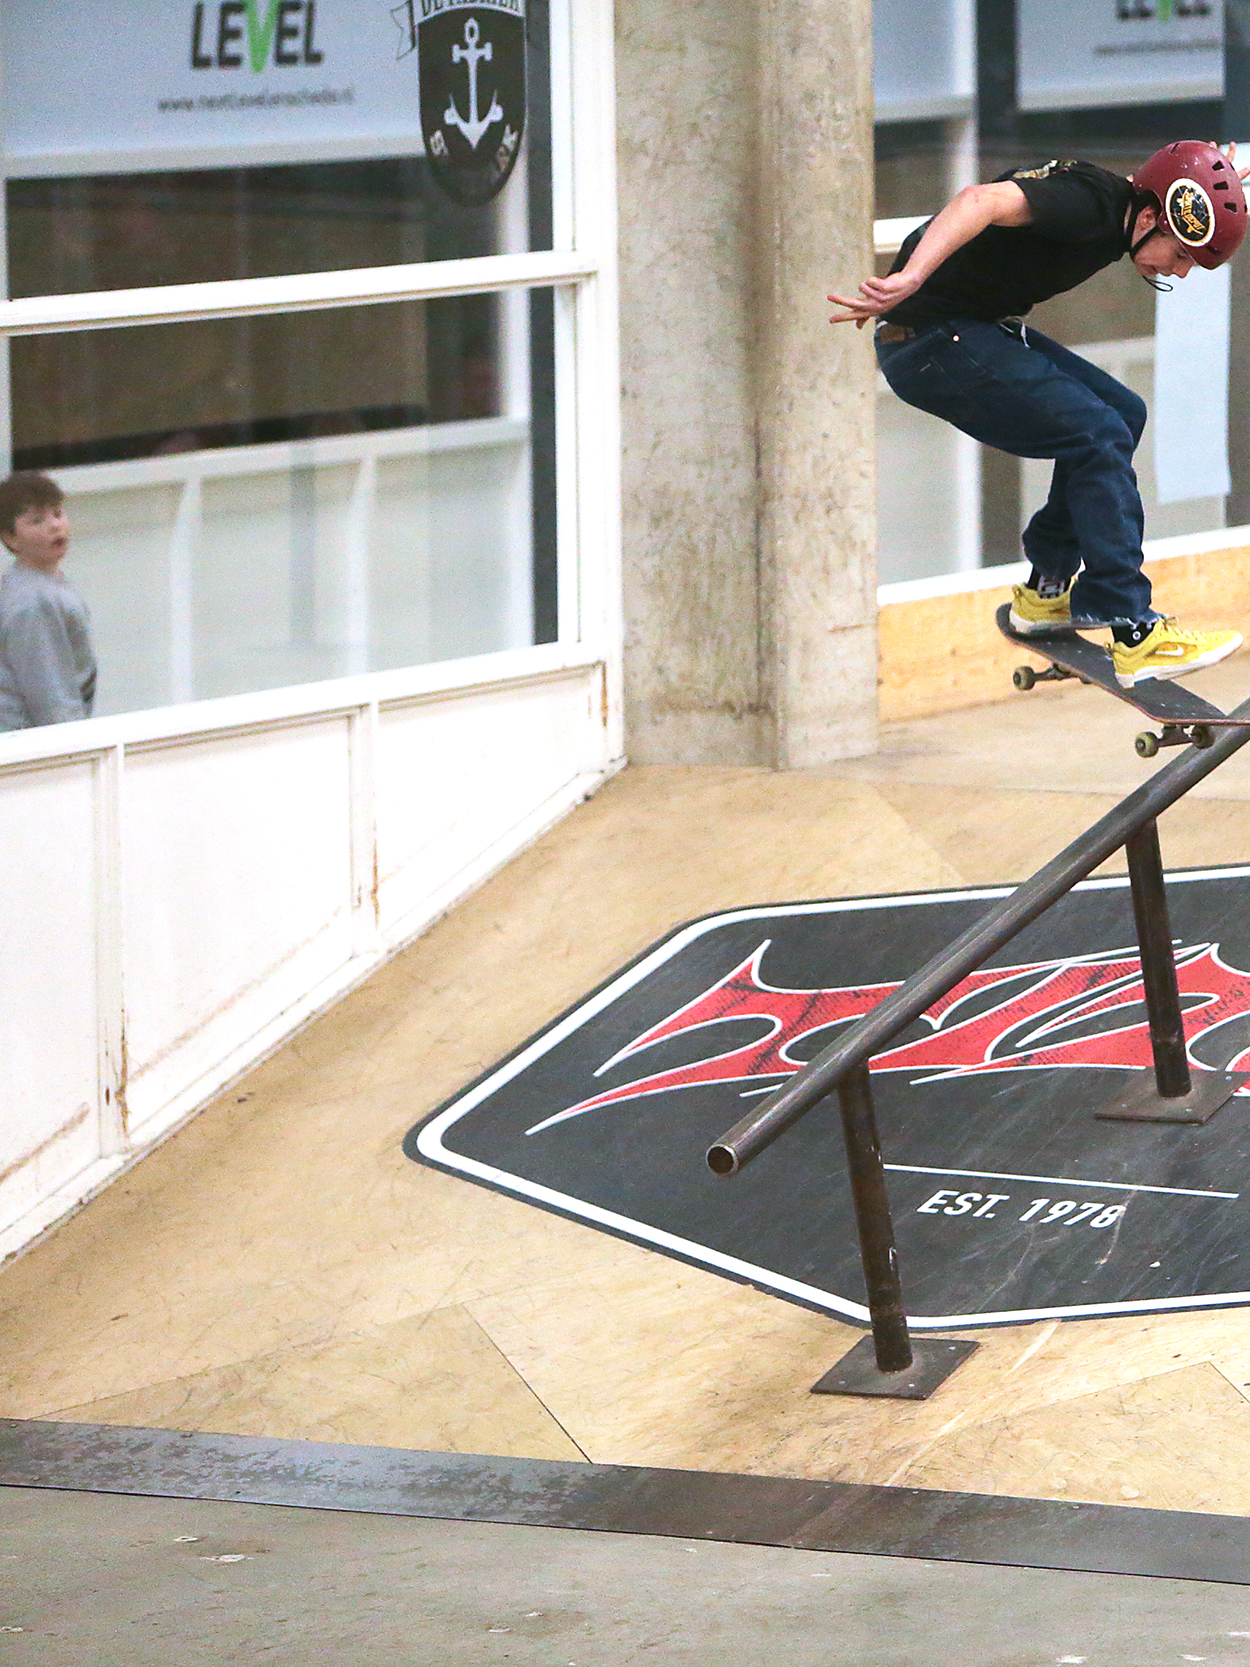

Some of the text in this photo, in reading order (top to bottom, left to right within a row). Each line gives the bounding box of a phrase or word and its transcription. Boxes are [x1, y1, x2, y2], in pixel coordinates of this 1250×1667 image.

[190, 0, 325, 73] LEVEL
[917, 1189, 1127, 1229] EST. 1978
